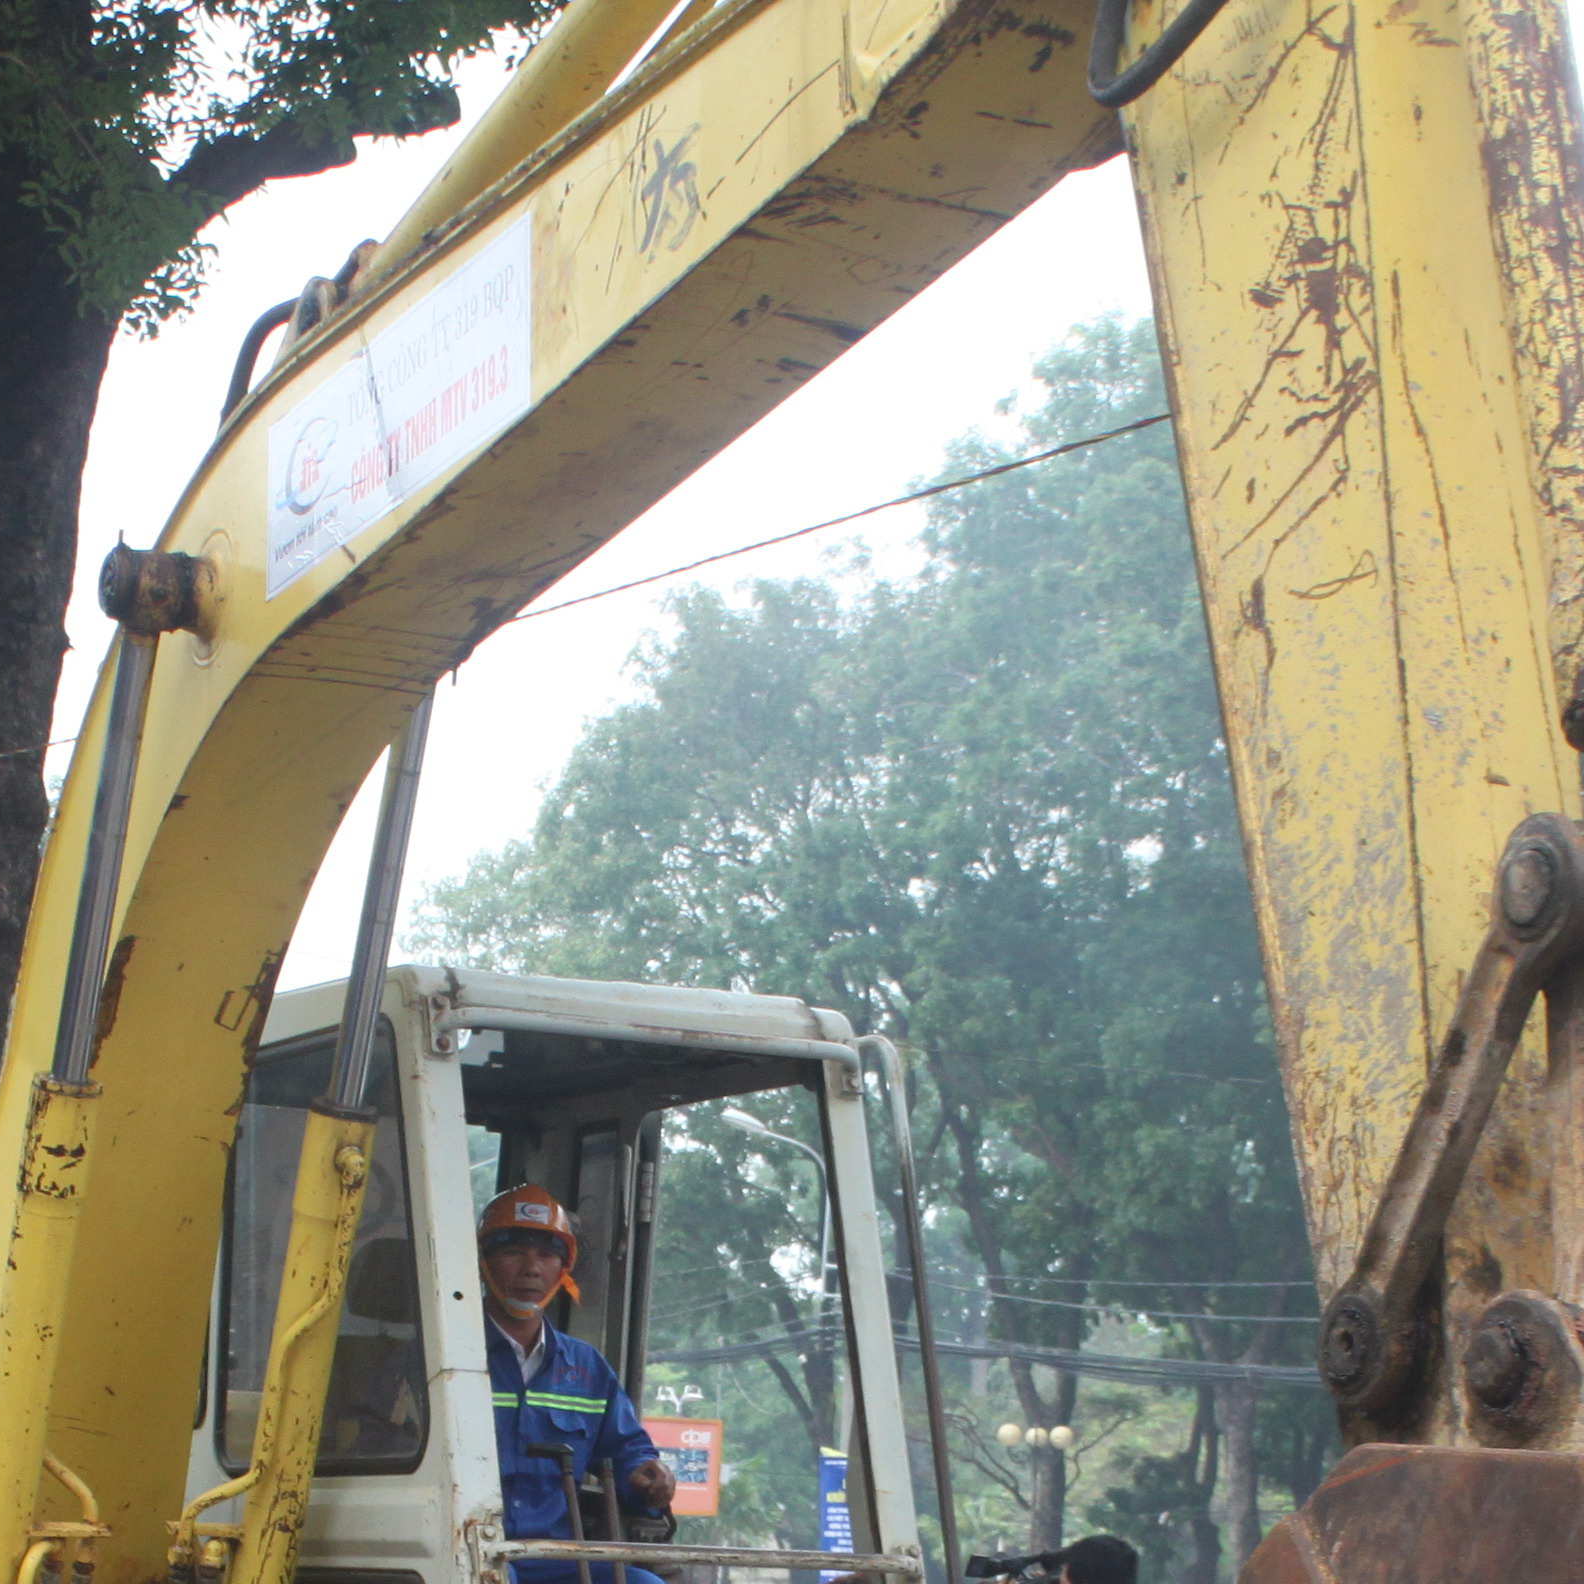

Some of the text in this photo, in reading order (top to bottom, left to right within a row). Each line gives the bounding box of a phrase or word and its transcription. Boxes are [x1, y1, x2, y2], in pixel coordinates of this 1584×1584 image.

[388, 328, 427, 395] CÔNG
[455, 293, 478, 341] 319
[483, 263, 514, 322] BQP
[350, 440, 385, 505] CÔNG
[386, 426, 401, 479] TY
[405, 398, 436, 465] TNHH
[441, 373, 467, 437] MTV
[471, 342, 508, 414] 319.3
